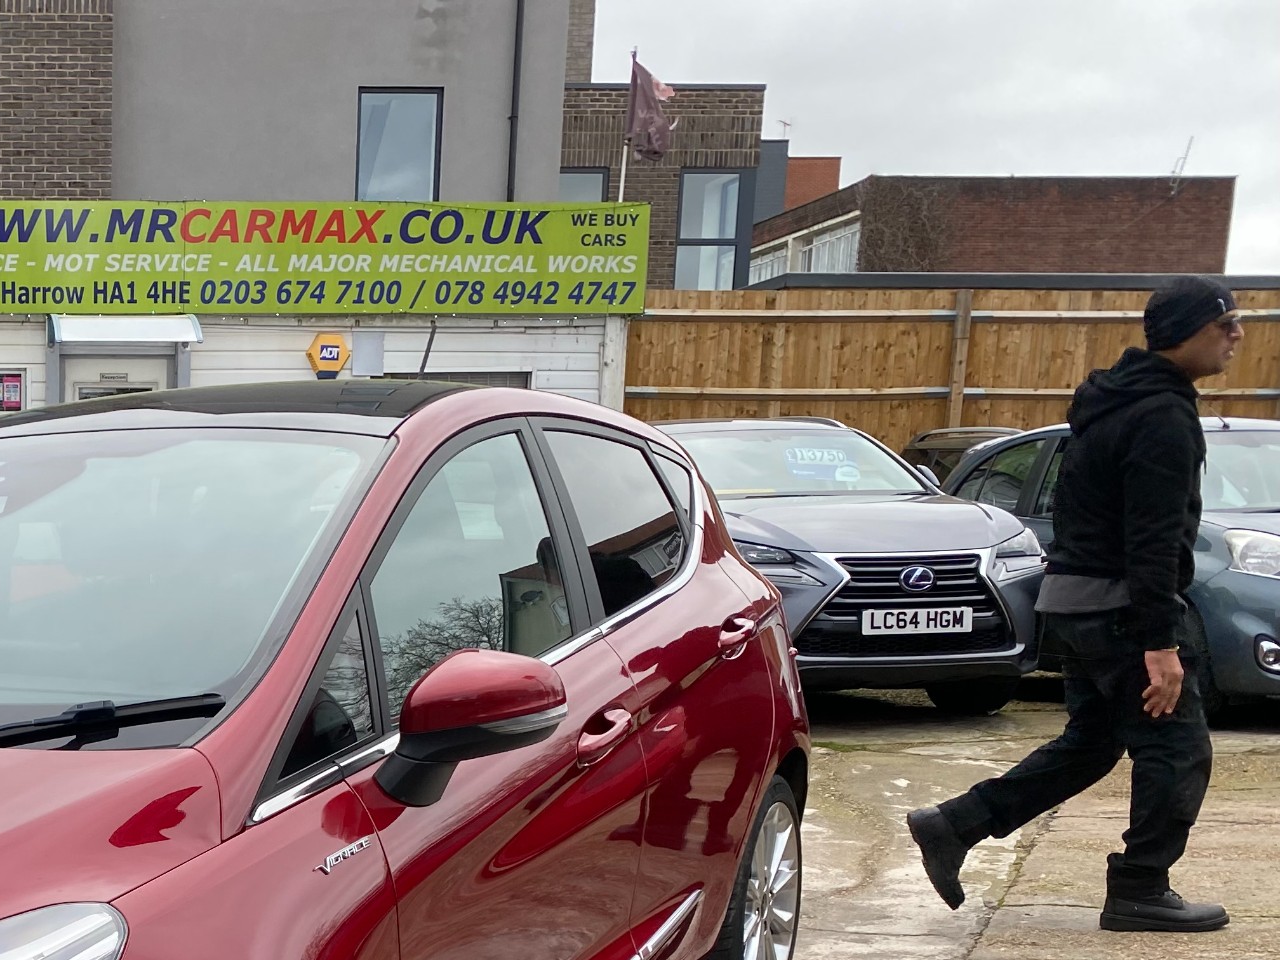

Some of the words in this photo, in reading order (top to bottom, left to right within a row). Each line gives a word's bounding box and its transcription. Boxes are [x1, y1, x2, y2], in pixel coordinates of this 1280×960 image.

[571, 213, 598, 226] WE
[604, 213, 640, 226] BUY
[581, 233, 626, 246] CARS
[44, 253, 99, 272] MOT
[105, 253, 212, 272] SERVICE
[235, 254, 279, 272] ALL
[287, 254, 371, 273] MAJOR
[379, 254, 537, 273] MECHANICAL
[548, 255, 638, 274] WORKS
[1, 281, 84, 304] Harrow
[93, 281, 138, 304] HA1
[147, 281, 191, 304] 4HE
[200, 280, 267, 304] 0203
[276, 280, 325, 304] 674
[335, 280, 402, 304] 7100
[435, 280, 485, 305] 078
[493, 281, 559, 305] 4942
[568, 281, 636, 305] 4747
[320, 347, 339, 358] ADT
[870, 611, 920, 630] LC64
[926, 610, 964, 628] HGM
